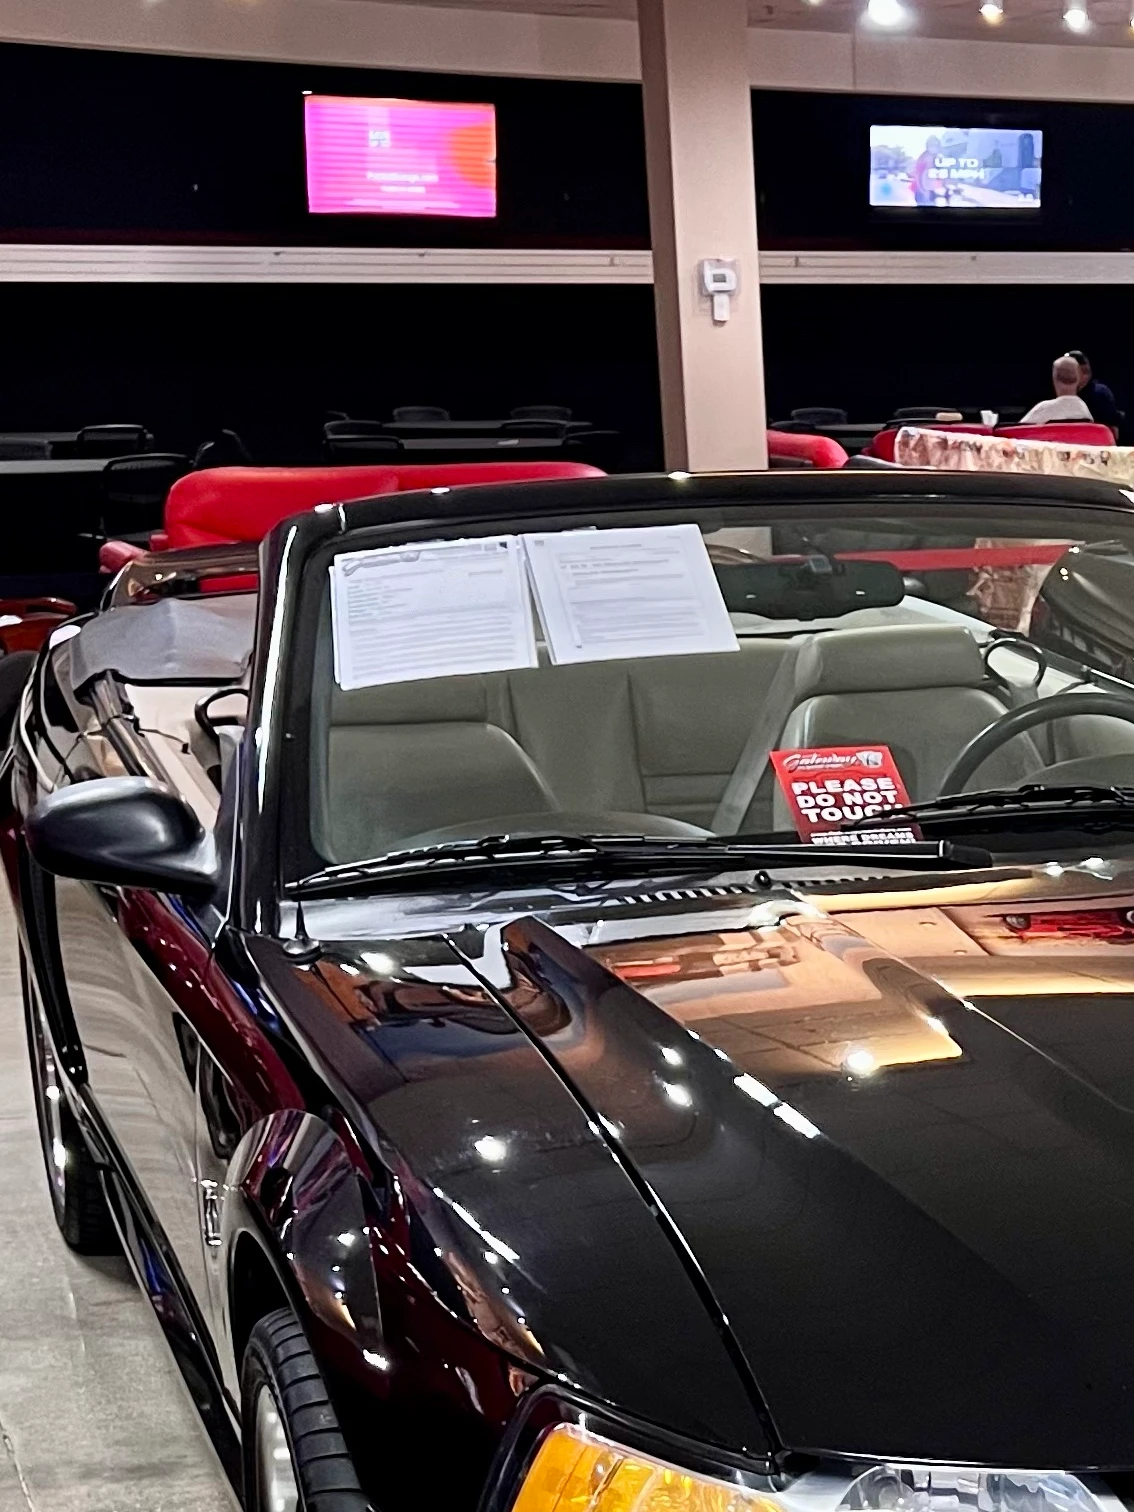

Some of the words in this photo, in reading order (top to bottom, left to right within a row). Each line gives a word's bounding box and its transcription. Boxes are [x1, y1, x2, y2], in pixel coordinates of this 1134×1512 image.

[958, 158, 979, 168] TO
[791, 777, 896, 795] PLEASE
[796, 793, 836, 808] DO
[842, 790, 898, 806] NOT
[811, 834, 860, 845] WHERE
[861, 832, 914, 842] DREAMS
